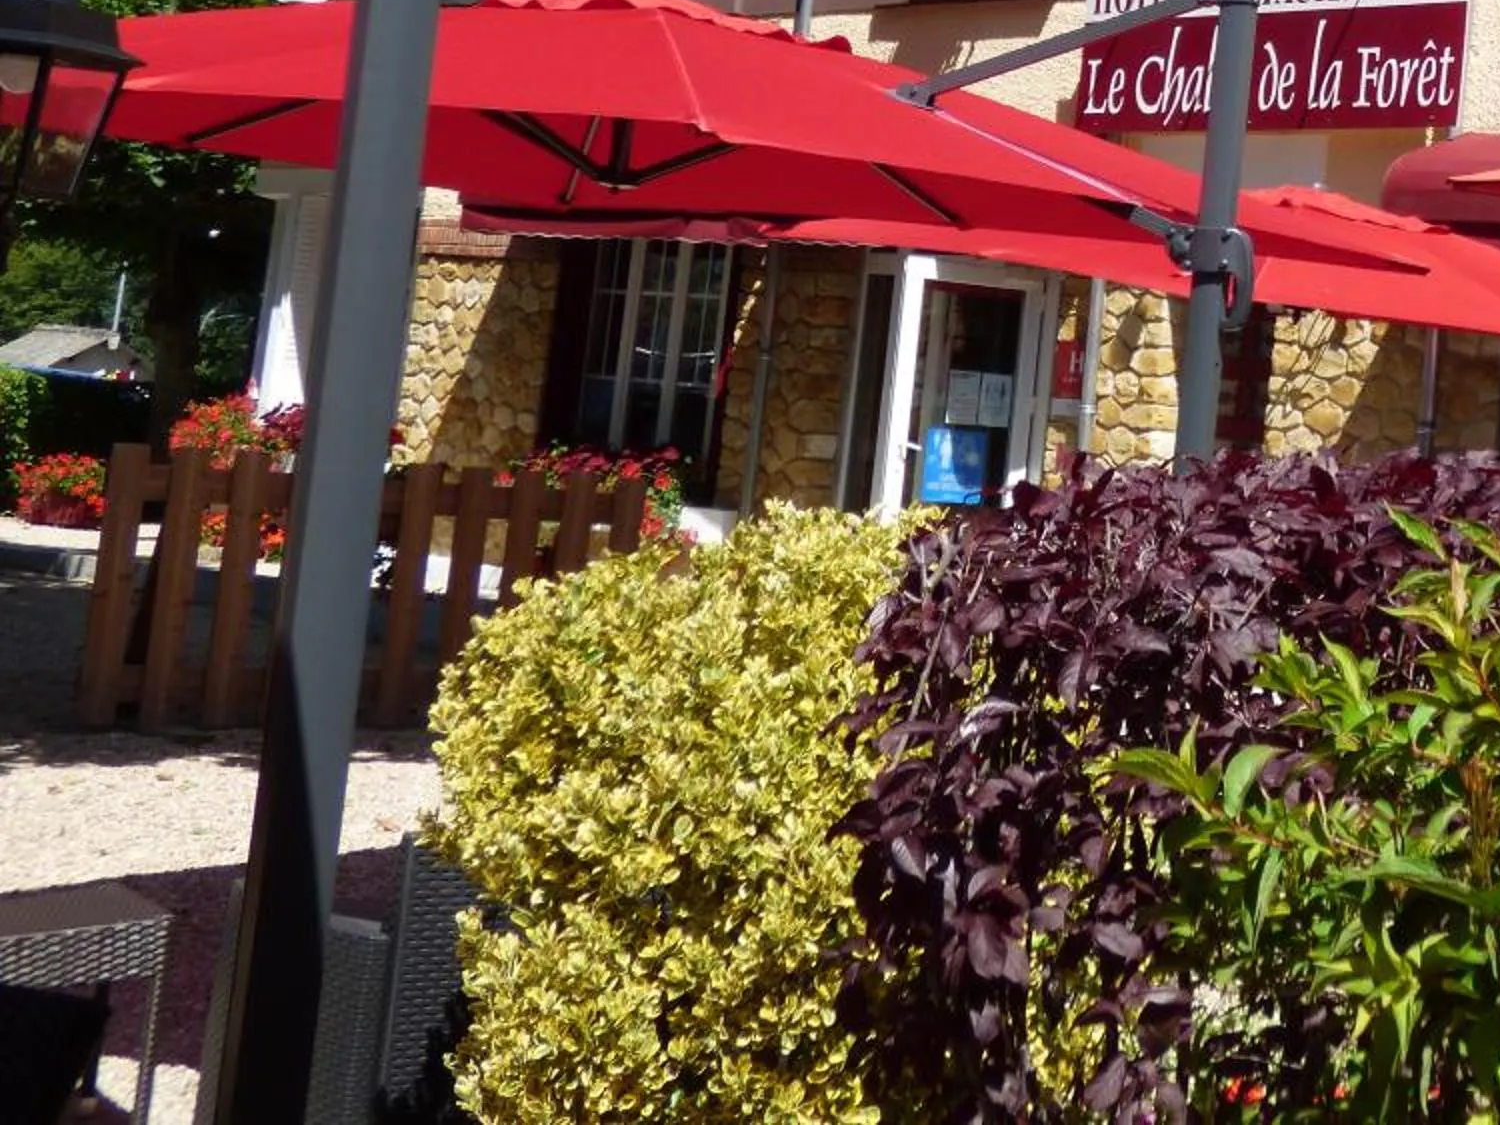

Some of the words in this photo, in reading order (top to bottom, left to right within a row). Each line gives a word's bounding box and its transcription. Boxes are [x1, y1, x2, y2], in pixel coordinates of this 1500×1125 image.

[1083, 59, 1126, 115] Le
[1135, 25, 1219, 127] Chal
[1257, 41, 1296, 112] de
[1307, 18, 1344, 111] la
[1351, 38, 1456, 109] Forêt
